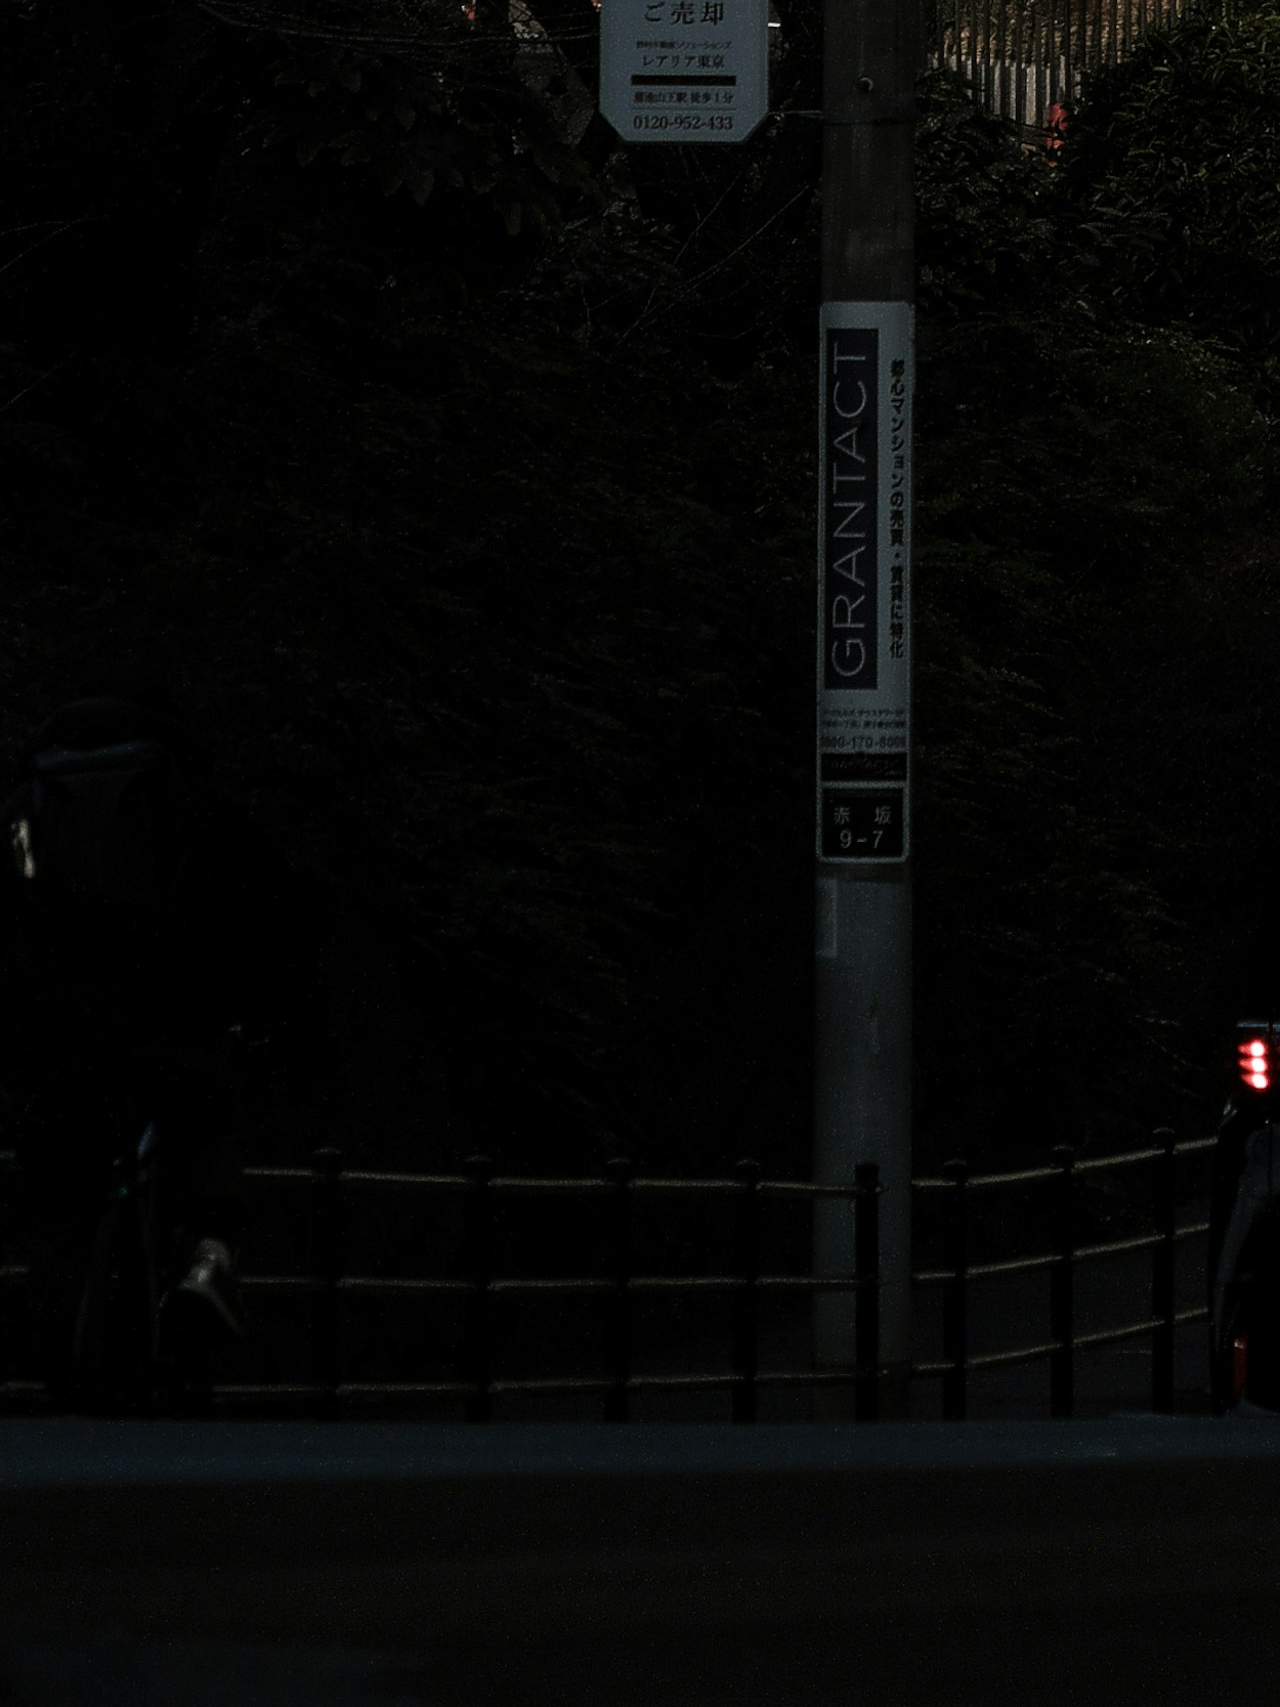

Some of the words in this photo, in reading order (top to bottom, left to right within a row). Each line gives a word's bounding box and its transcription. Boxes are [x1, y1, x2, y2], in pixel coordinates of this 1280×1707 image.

[644, 1, 724, 26] ご売却
[642, 54, 725, 70] レアリア東京
[632, 115, 734, 131] 0120-952-433
[832, 341, 868, 677] GRANTACT
[832, 804, 894, 826] 赤坂
[839, 827, 885, 850] 9-7
